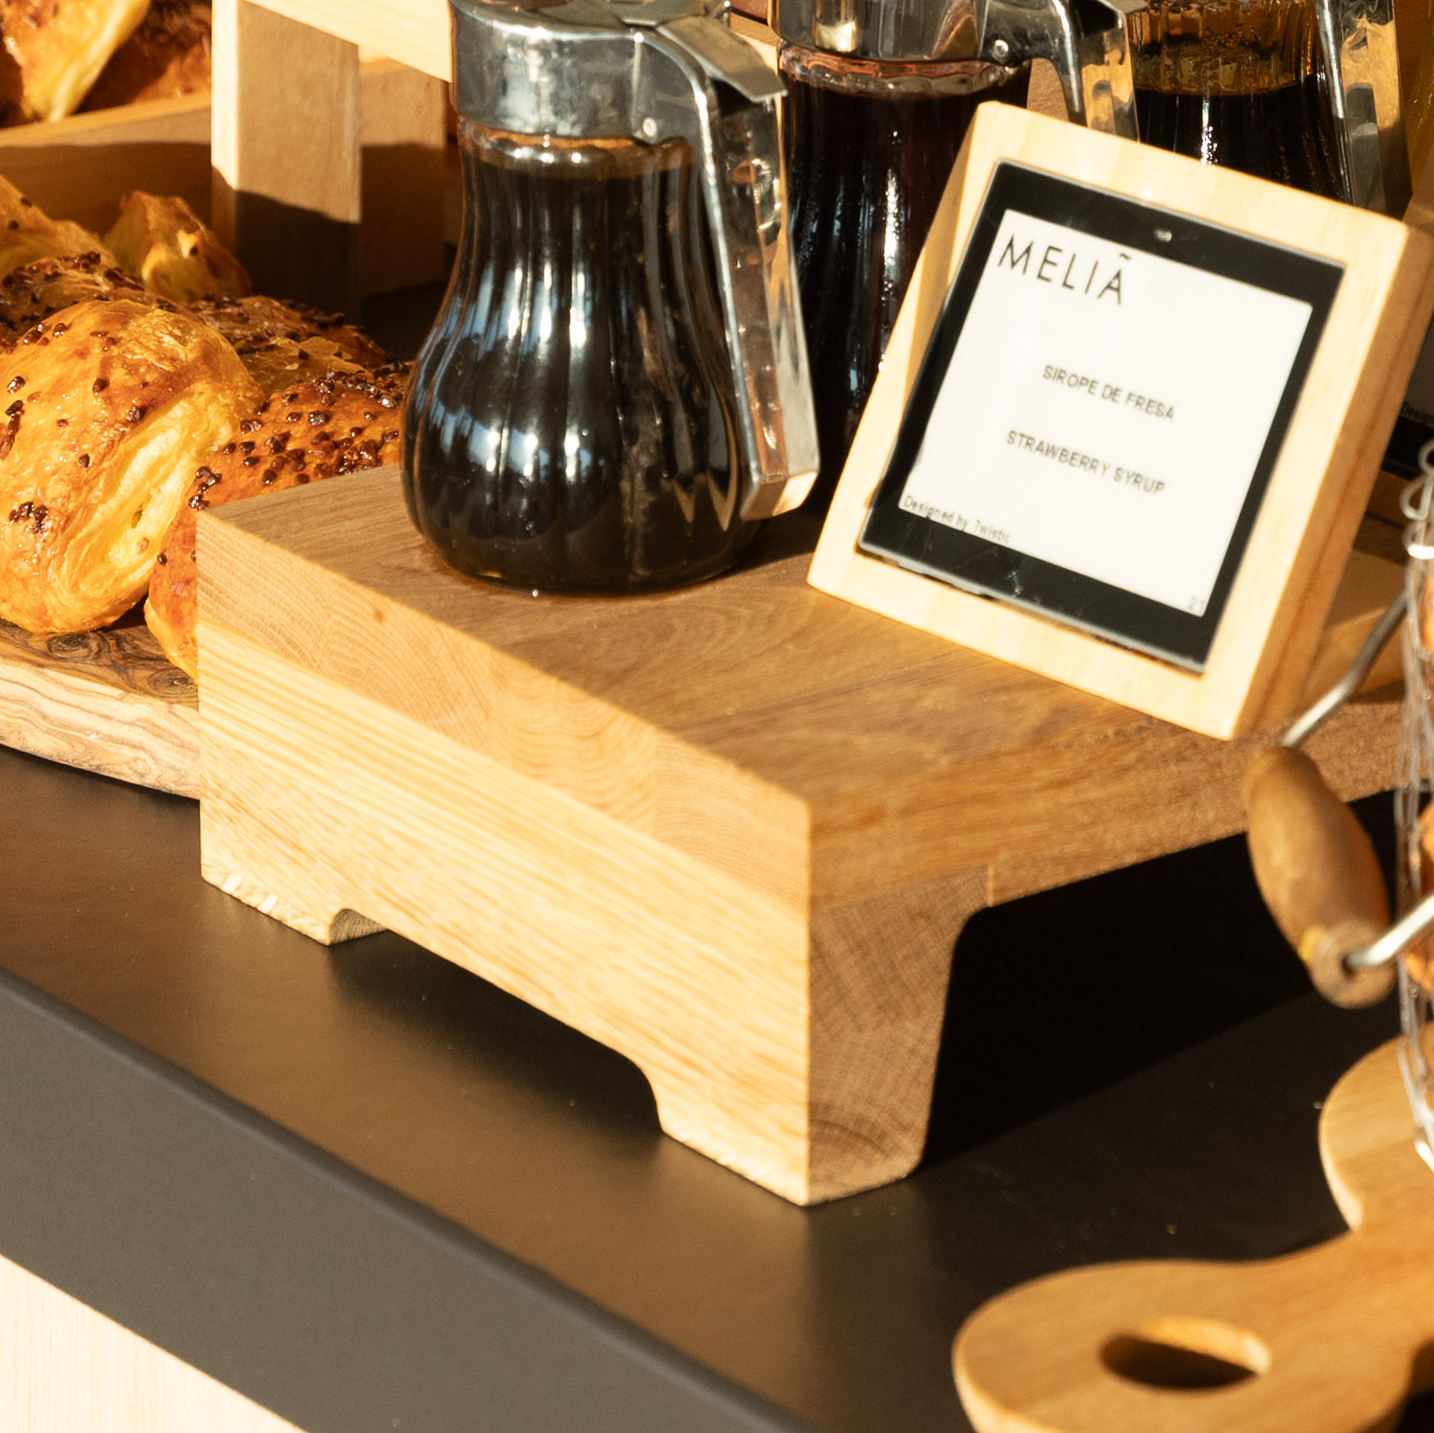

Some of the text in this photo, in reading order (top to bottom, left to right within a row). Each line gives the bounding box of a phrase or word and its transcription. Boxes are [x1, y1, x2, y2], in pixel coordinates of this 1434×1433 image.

[1042, 364, 1175, 421] SIROPE DE FRESA
[1006, 430, 1166, 495] STRAWBERRY SYRUP
[904, 495, 955, 523] Designed
[956, 513, 969, 532] by
